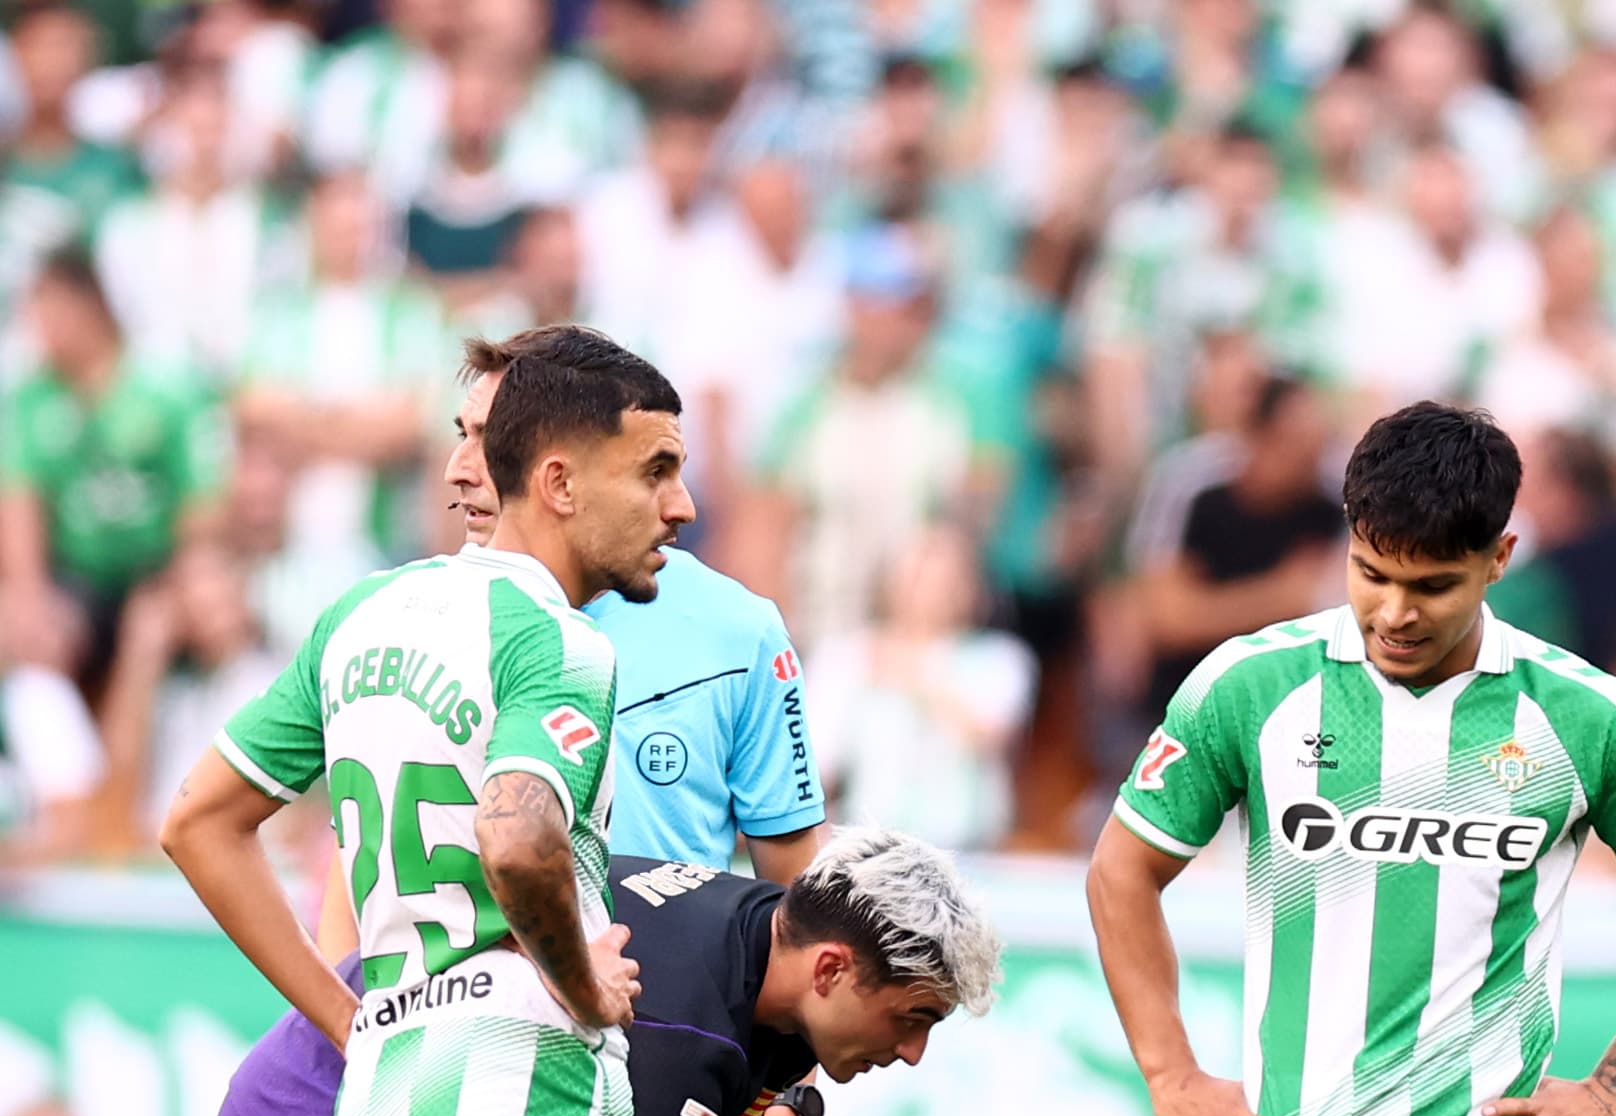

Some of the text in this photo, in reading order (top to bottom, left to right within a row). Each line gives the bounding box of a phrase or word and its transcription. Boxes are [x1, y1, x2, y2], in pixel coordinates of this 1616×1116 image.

[342, 647, 482, 745] CEBALLOS
[1297, 757, 1339, 770] hummel
[329, 757, 512, 992] 25
[1350, 814, 1539, 862] GREE
